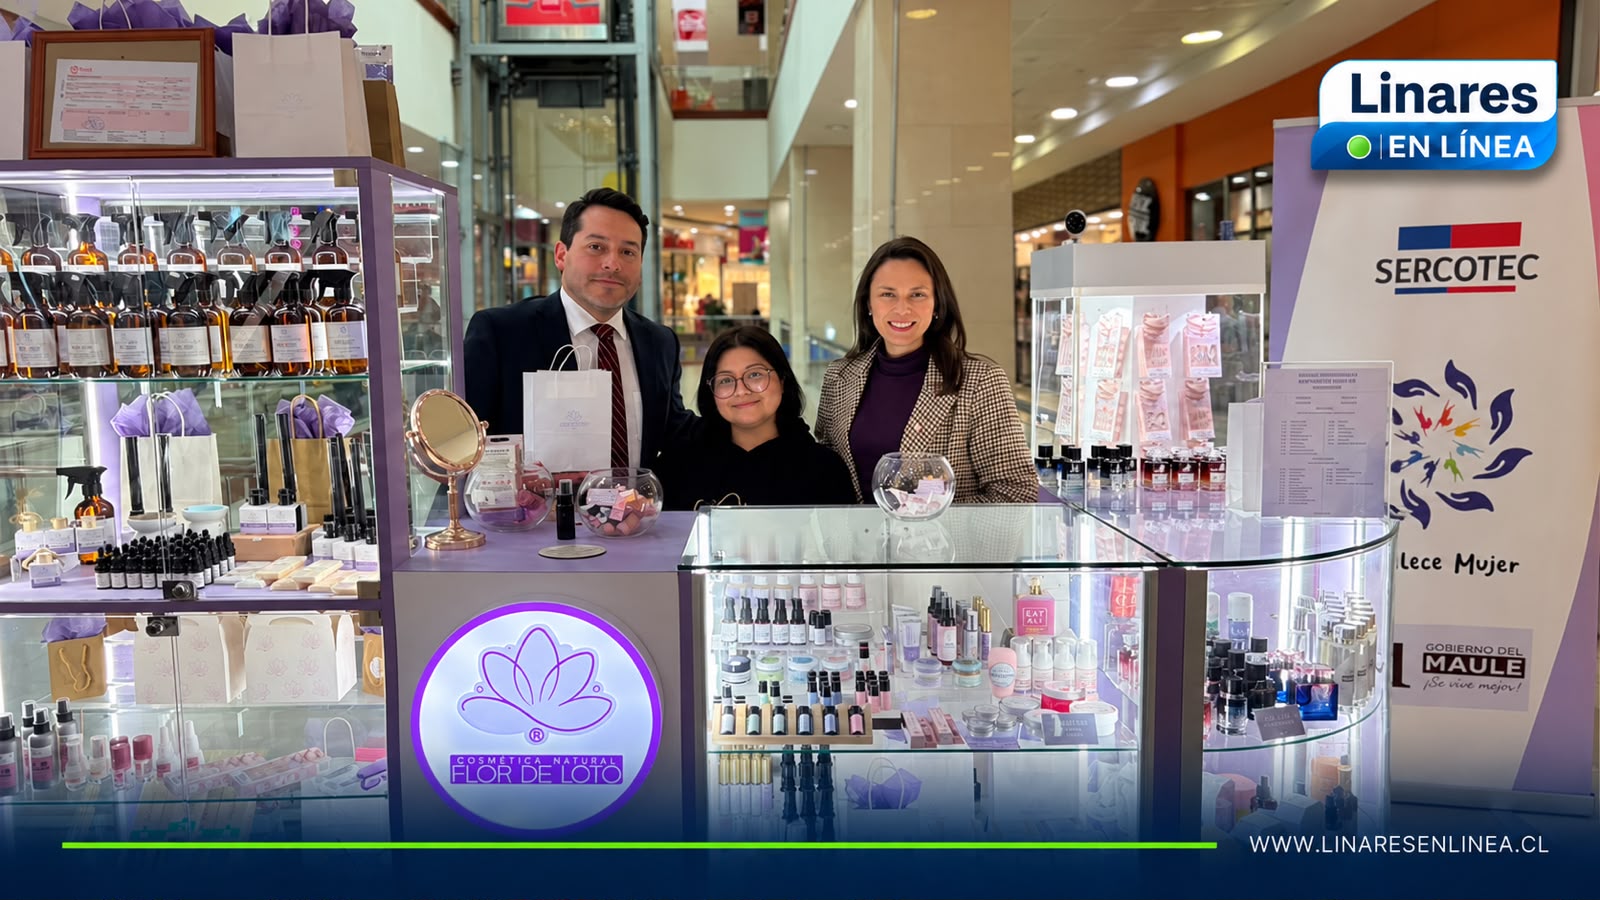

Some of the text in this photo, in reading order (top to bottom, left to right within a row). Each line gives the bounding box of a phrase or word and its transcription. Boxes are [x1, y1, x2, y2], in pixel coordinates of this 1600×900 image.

[1375, 253, 1540, 284] SERCOTEC
[1396, 552, 1520, 577] lece Mujer
[1425, 643, 1524, 657] GOBIERNO DEL
[1425, 655, 1523, 676] MAULE
[1449, 679, 1474, 690] vive
[456, 755, 616, 765] COSMÉTICA NATURAL
[452, 764, 622, 784] FLOR DE LOTO
